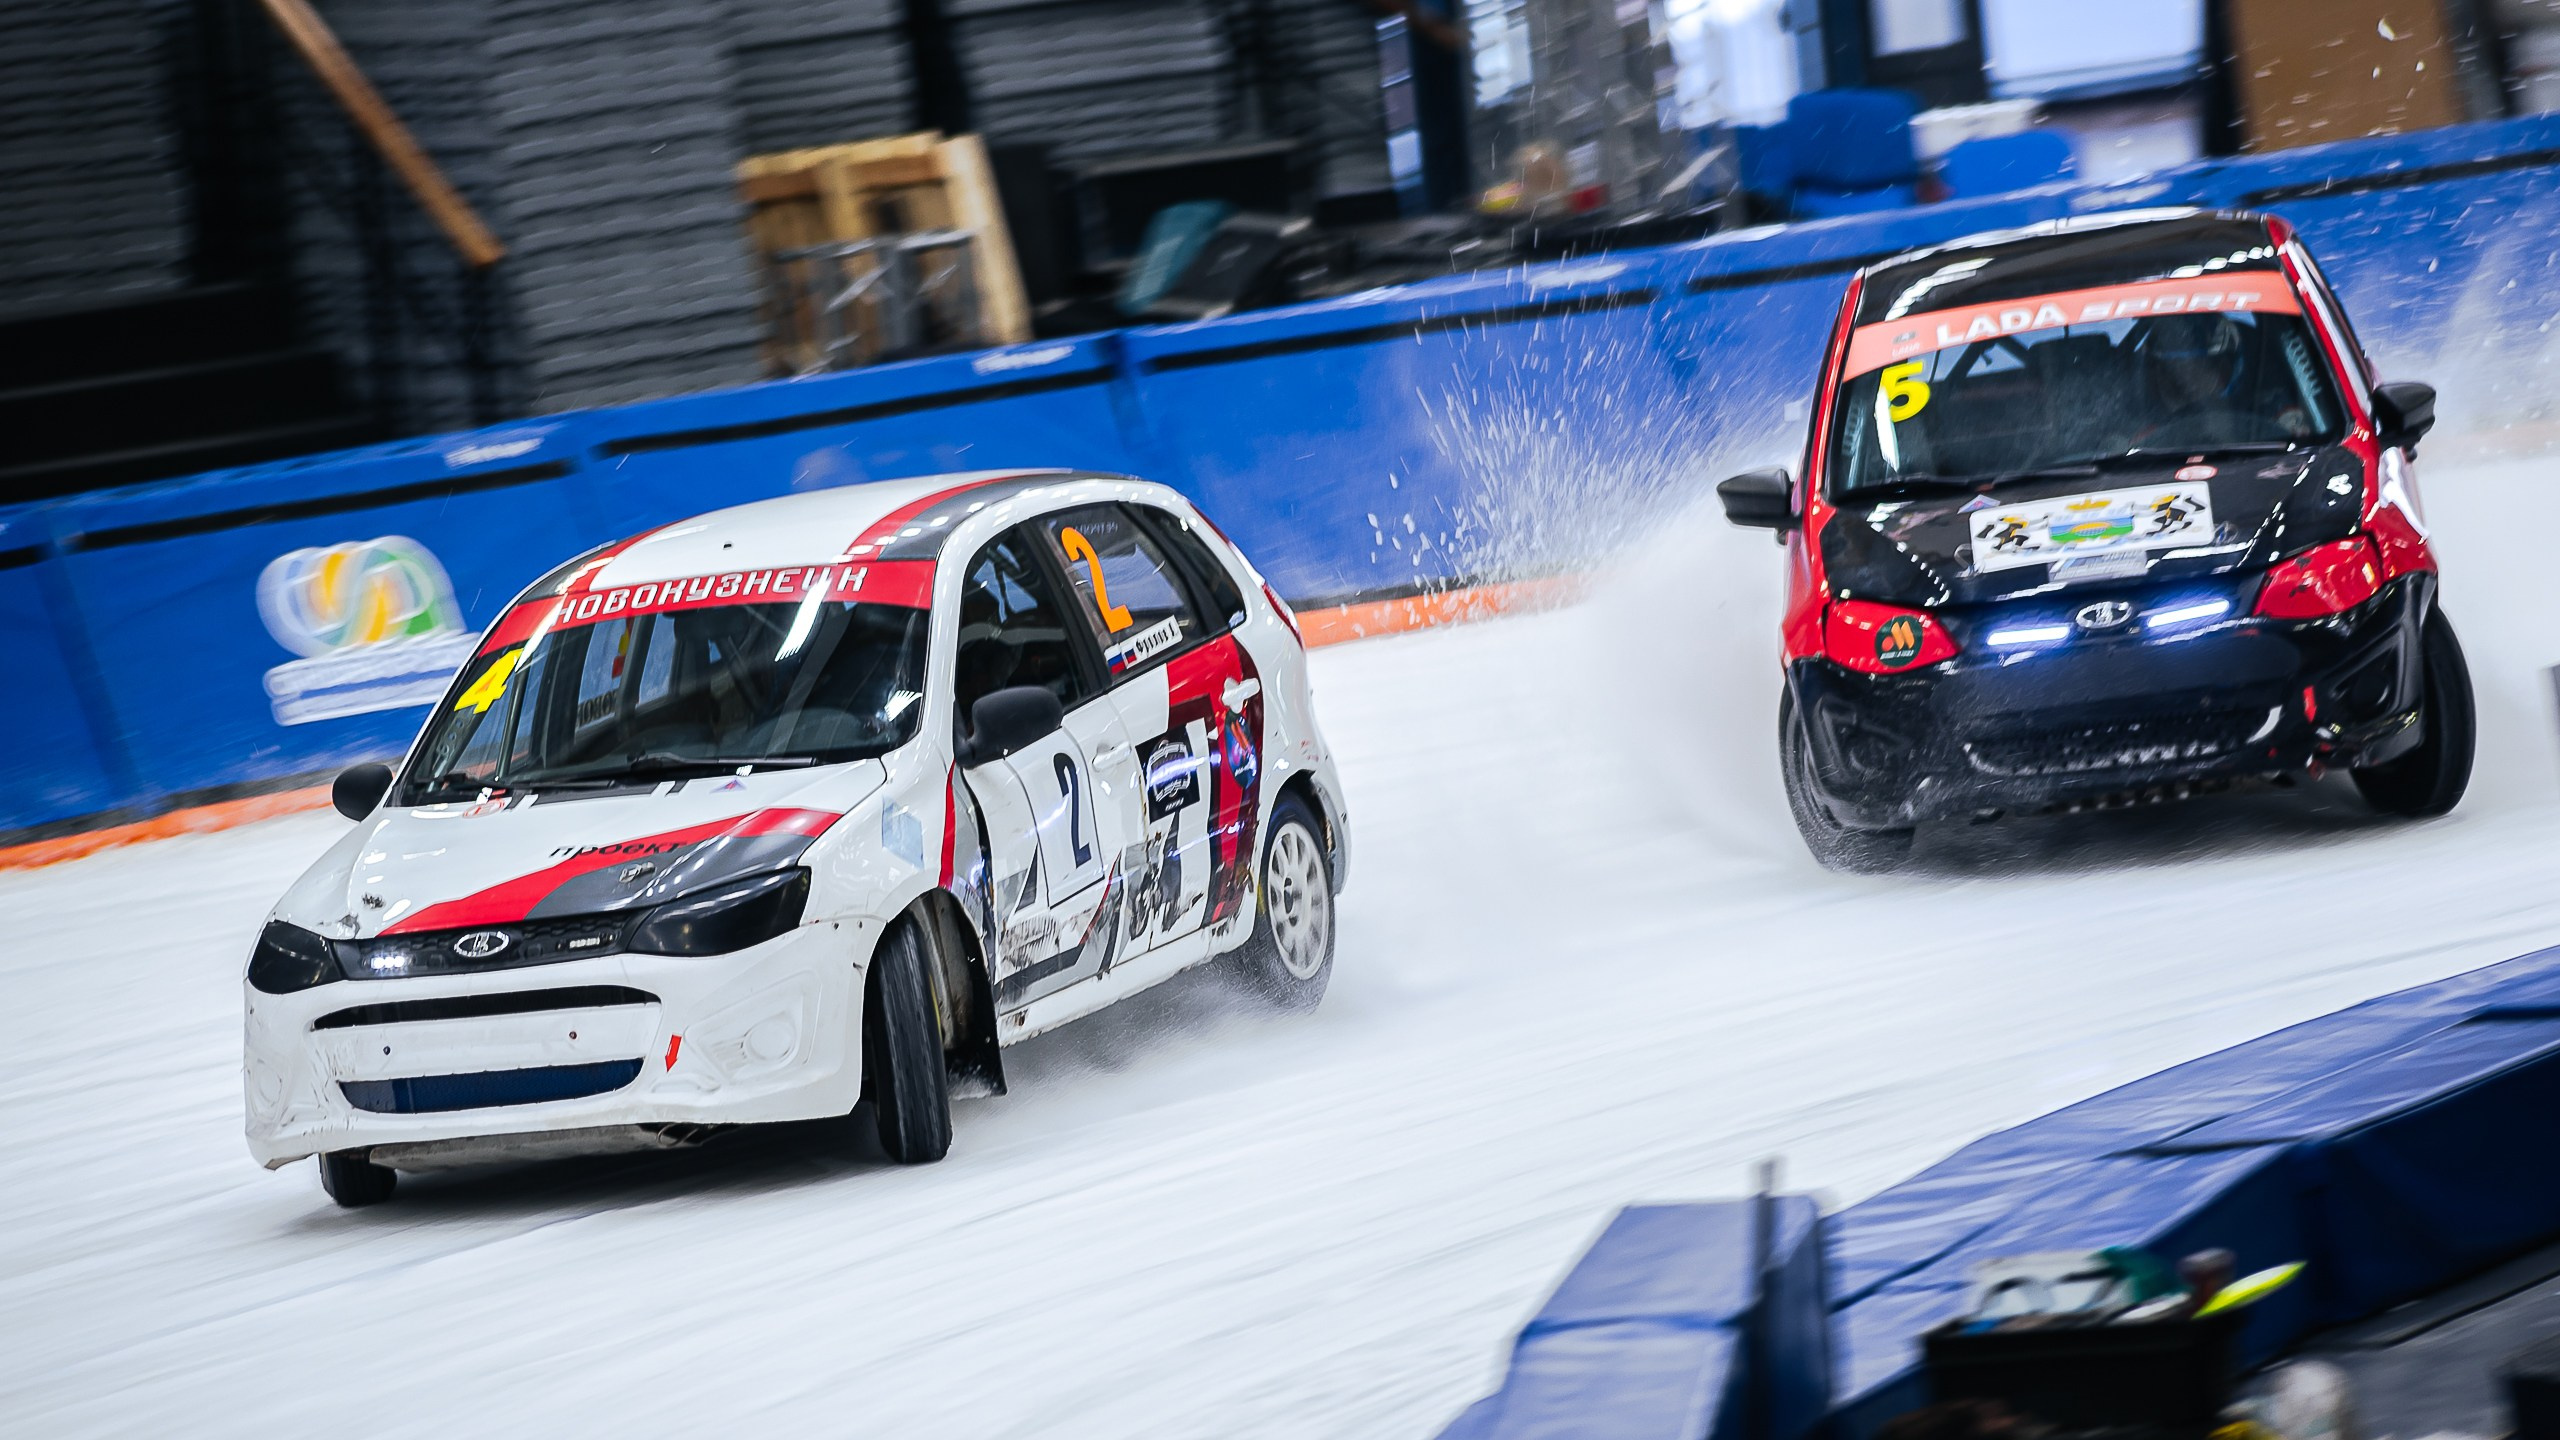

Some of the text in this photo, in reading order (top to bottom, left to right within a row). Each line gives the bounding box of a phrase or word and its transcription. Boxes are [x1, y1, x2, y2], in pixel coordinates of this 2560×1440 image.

[1936, 292, 2262, 348] LADA SPORT
[1881, 361, 1931, 423] 5
[554, 566, 869, 625] НОВОКУЗНЕЦК
[1061, 527, 1133, 633] 2
[454, 648, 524, 715] 4
[1053, 752, 1092, 869] 2
[549, 842, 688, 860] проект
